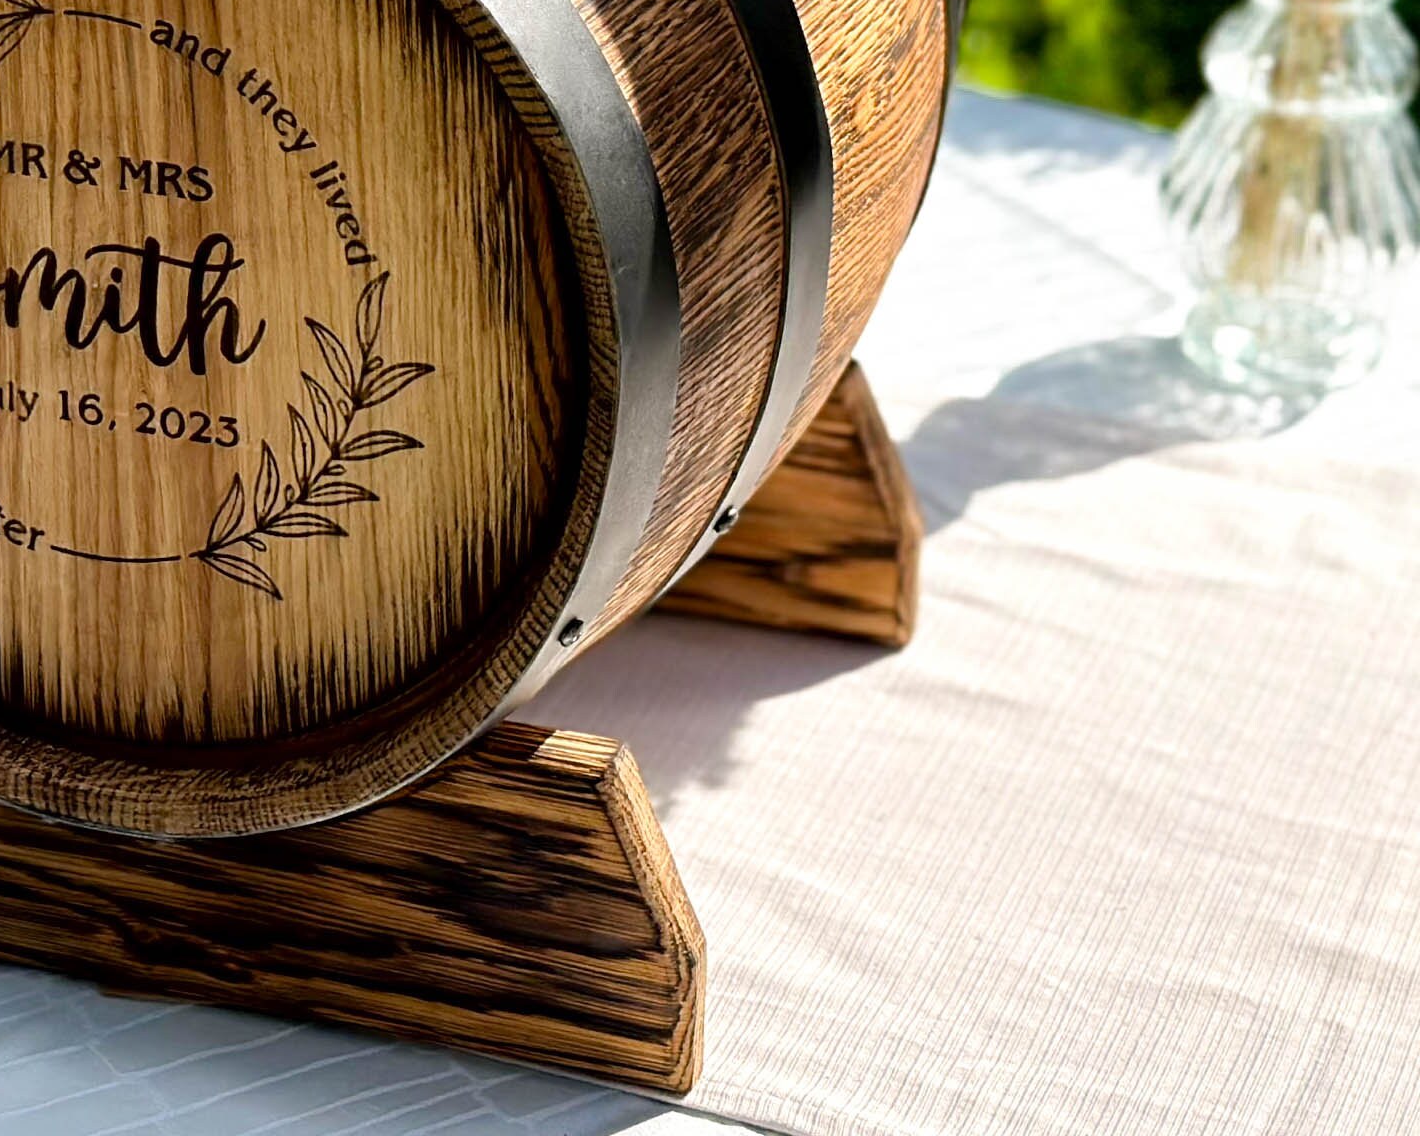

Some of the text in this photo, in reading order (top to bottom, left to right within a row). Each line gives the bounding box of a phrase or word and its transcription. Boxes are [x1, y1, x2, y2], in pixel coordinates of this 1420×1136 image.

[149, 18, 379, 267] and they lived
[63, 149, 101, 186] &
[118, 156, 214, 202] MRS
[58, 390, 117, 432] 16,
[135, 402, 241, 448] 2023
